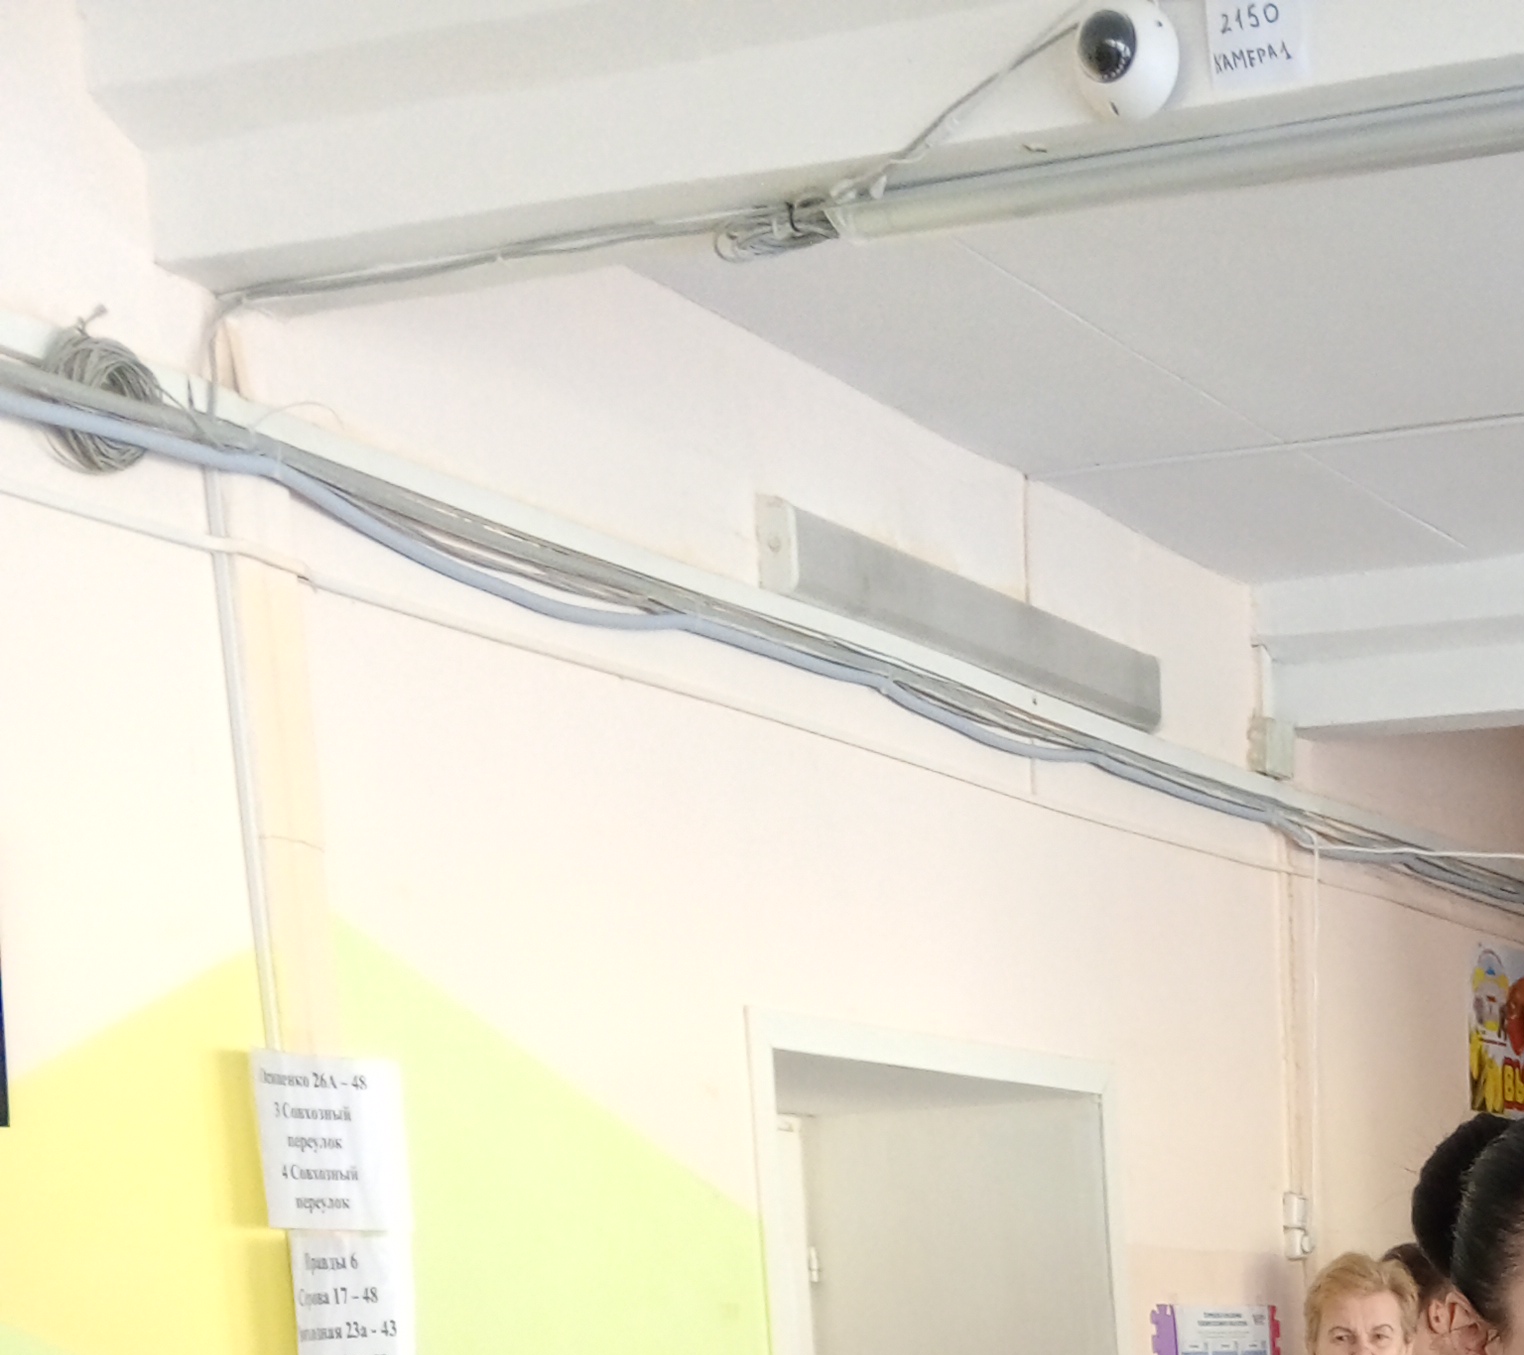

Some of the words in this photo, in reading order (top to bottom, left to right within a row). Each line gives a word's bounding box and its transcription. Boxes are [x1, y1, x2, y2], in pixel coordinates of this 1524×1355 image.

[1221, 3, 1279, 34] 2150
[1213, 44, 1278, 74] КАМЕРА
[1281, 40, 1292, 60] 1
[351, 1074, 368, 1090] 48
[273, 1102, 281, 1119] 3
[283, 1102, 352, 1122] Совхозный
[287, 1135, 342, 1153] переулок
[281, 1164, 288, 1181] 4
[290, 1164, 359, 1182] Совхозный
[295, 1196, 350, 1215] переулок
[350, 1252, 358, 1270] 6
[333, 1287, 347, 1305] 17
[362, 1286, 379, 1303] 48
[380, 1320, 397, 1337] 43
